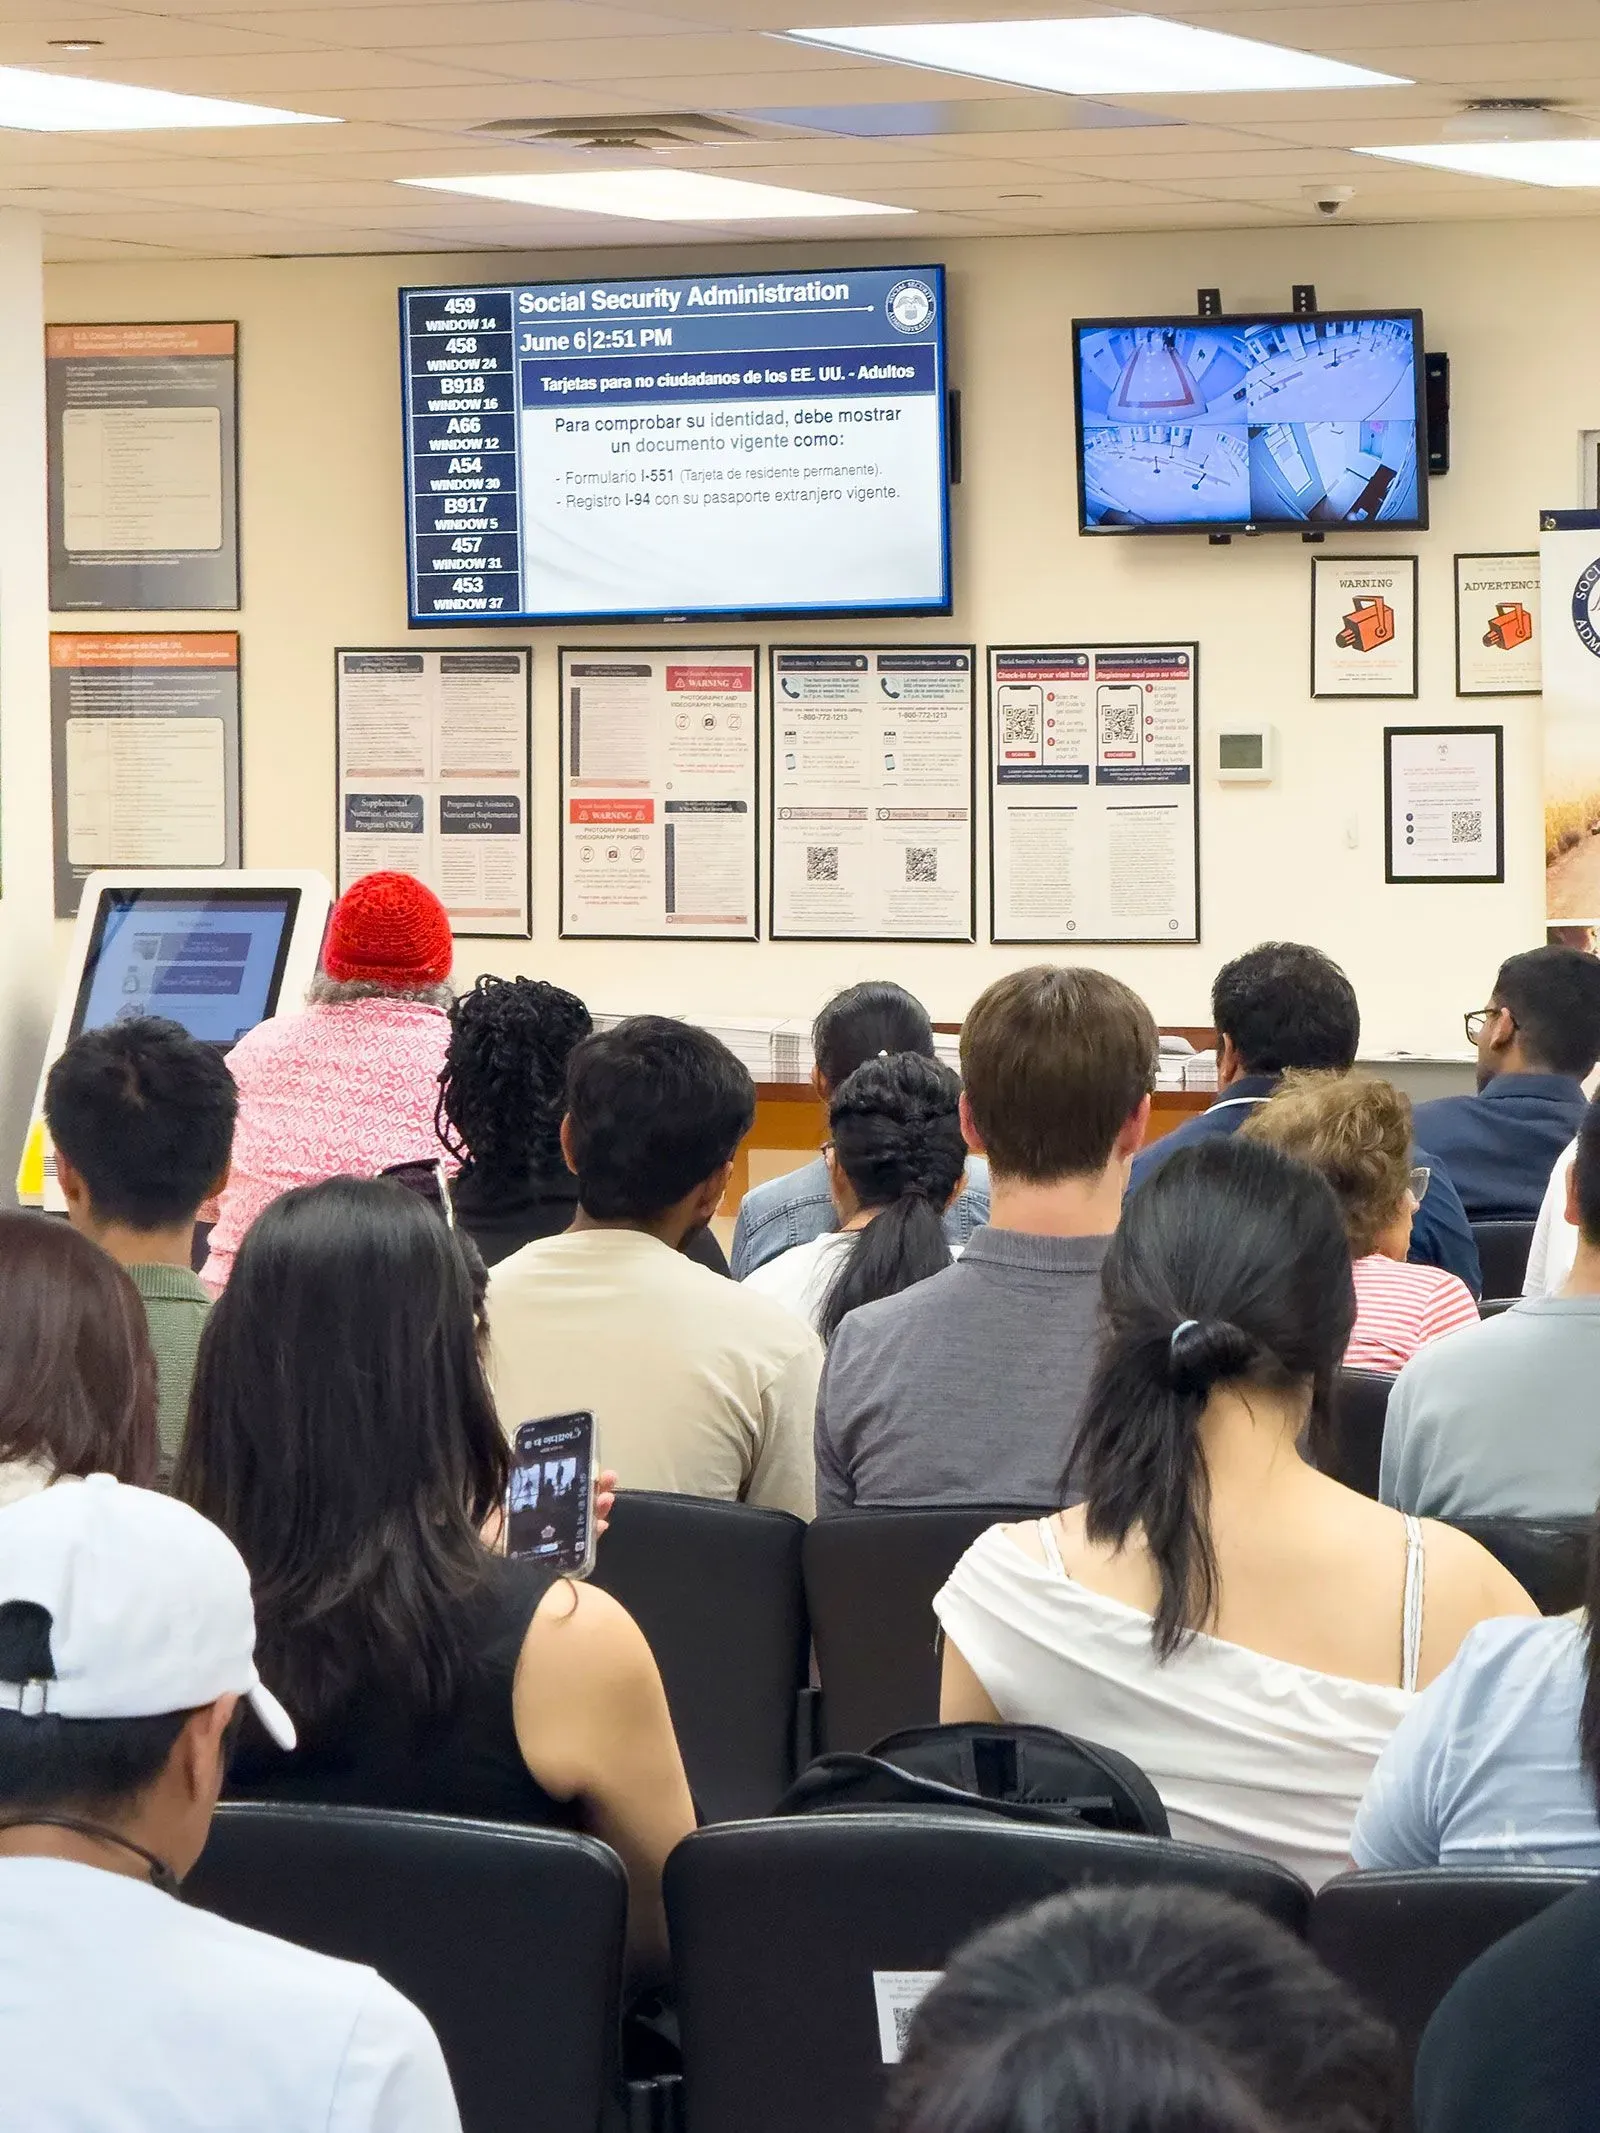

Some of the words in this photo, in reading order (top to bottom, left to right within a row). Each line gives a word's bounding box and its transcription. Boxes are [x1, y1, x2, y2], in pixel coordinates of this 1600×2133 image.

[444, 297, 476, 314] 459
[519, 290, 585, 314] Social
[591, 287, 682, 312] Security
[686, 281, 849, 306] Administration
[425, 319, 479, 331] WINDOW
[481, 318, 496, 330] 14
[445, 337, 477, 354] 458
[520, 333, 570, 352] June
[640, 328, 672, 347] PM
[426, 358, 481, 371] WINDOW
[481, 358, 498, 370] 24
[441, 377, 485, 394] B918
[540, 376, 597, 394] Tarjetas
[600, 376, 632, 393] para
[635, 375, 654, 387] no
[657, 371, 740, 387] ciudadanos
[743, 370, 763, 385] de
[764, 368, 787, 383] los
[790, 367, 815, 382] EE.
[818, 366, 845, 382] UU.
[857, 363, 915, 380] Adultos
[427, 398, 482, 412] WINDOW
[483, 398, 498, 409] 16
[446, 417, 481, 434] A66
[555, 418, 590, 432] Para
[595, 414, 681, 434] comprobar
[686, 416, 705, 428] su
[710, 409, 789, 428] identidad,
[794, 409, 833, 424] debe
[838, 407, 901, 423] mostrar
[429, 438, 483, 451] WINDOW
[485, 438, 499, 449] 12
[611, 441, 630, 453] un
[635, 436, 725, 452] documento
[730, 434, 789, 452] vigente
[793, 433, 844, 447] como:
[448, 457, 482, 474] A54
[565, 469, 637, 485] Formulario
[641, 469, 674, 482] I-551
[680, 468, 723, 484] (Tarjeta
[727, 468, 742, 479] de
[745, 466, 800, 480] residente
[803, 463, 882, 480] permanente).
[430, 478, 484, 491] WINDOW
[485, 478, 500, 489] 30
[444, 497, 488, 514] B917
[566, 494, 621, 511] Registro
[625, 493, 650, 506] I-94
[655, 495, 679, 506] con
[683, 494, 698, 504] su
[703, 489, 770, 507] pasaporte
[775, 487, 842, 504] extranjero
[846, 485, 900, 502] vigente.
[434, 518, 488, 531] WINDOW
[490, 518, 498, 529] 5
[451, 537, 482, 553] 457
[432, 558, 486, 570] WINDOW
[488, 558, 502, 569] 31
[452, 577, 484, 593] 453
[1340, 579, 1393, 588] WARNING
[433, 598, 487, 610] WINDOW
[489, 598, 504, 609] 37
[361, 799, 408, 808] Supplemental
[592, 811, 632, 819] WARNING
[356, 821, 384, 830] Program
